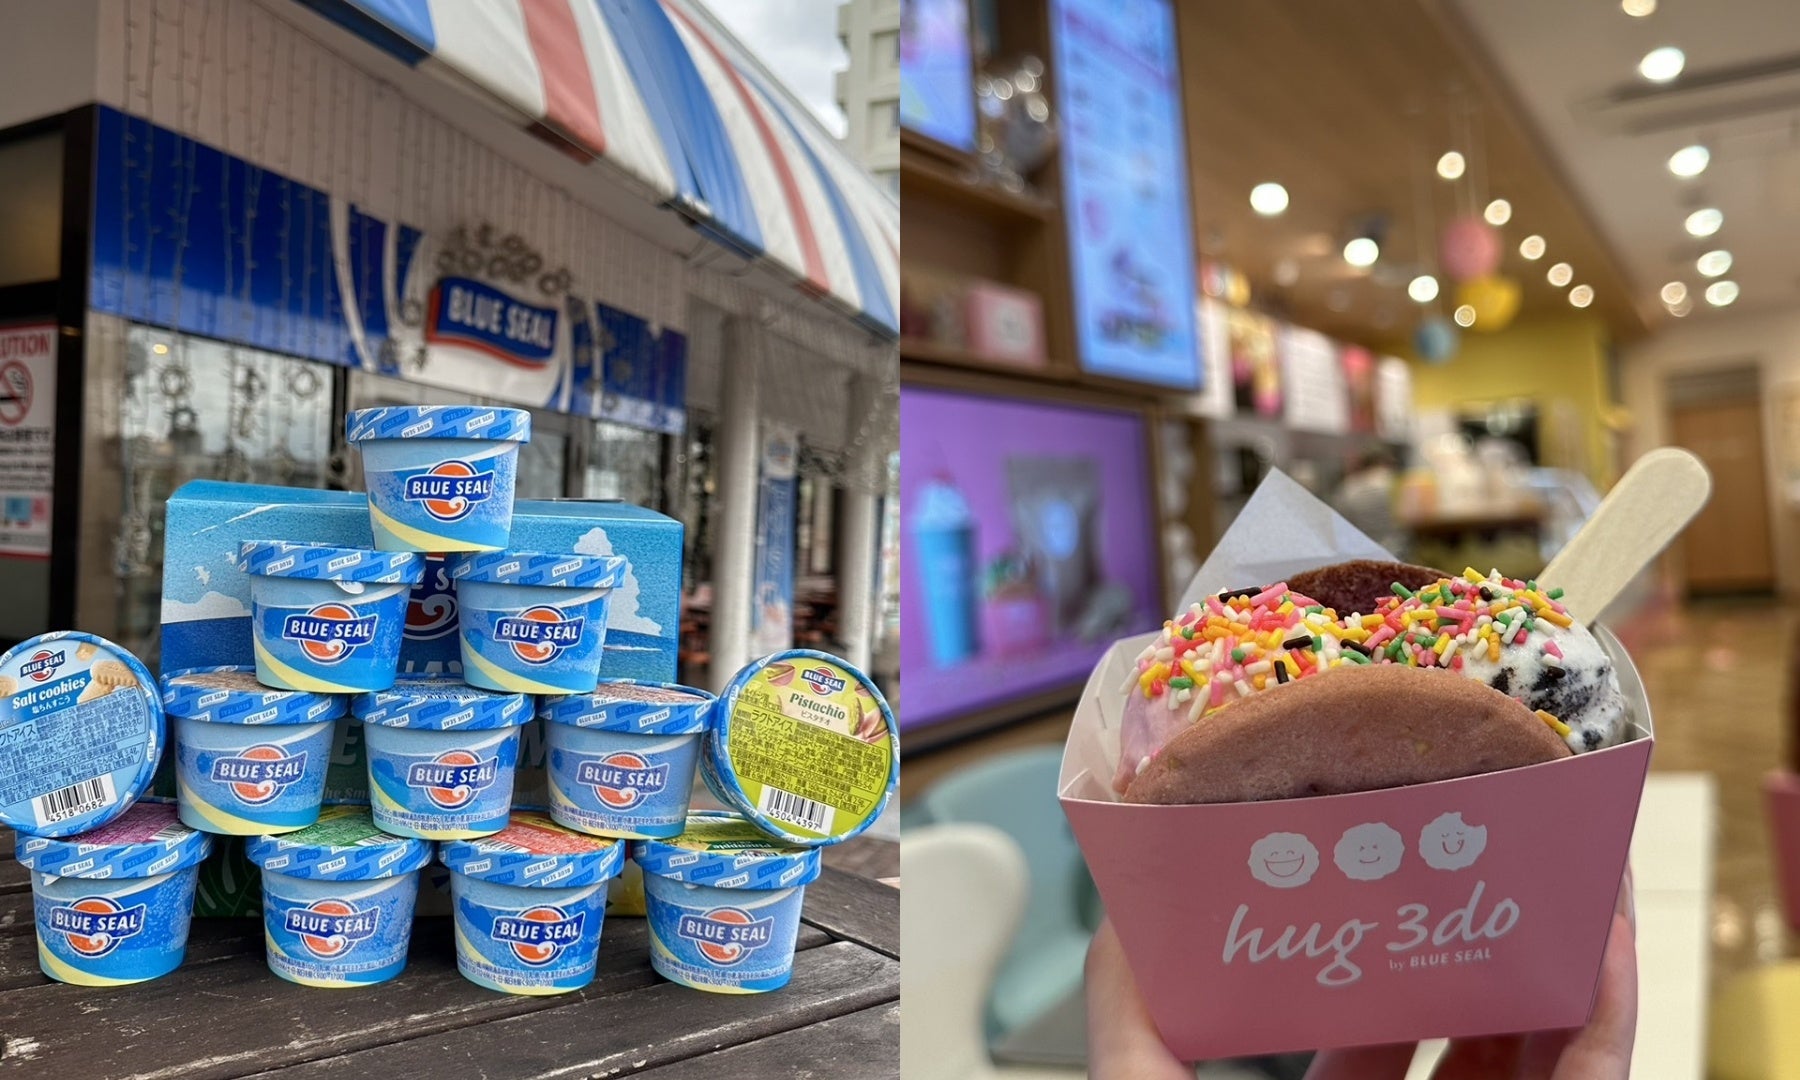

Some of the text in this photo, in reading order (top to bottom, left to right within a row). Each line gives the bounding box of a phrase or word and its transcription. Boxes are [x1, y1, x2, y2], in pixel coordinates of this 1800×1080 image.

[448, 285, 551, 350] BLUE SEAL
[0, 334, 49, 357] UTION
[412, 480, 489, 495] BLUE SEAL
[291, 620, 371, 638] BLUE SEAL
[501, 622, 578, 640] BLUE SEAL
[22, 654, 63, 674] BLUE SEAL
[803, 670, 843, 689] BLUE SEAL
[12, 677, 86, 710] Salt cookies
[789, 692, 846, 720] Pistachio
[751, 709, 793, 733] ラクトアイス
[220, 763, 300, 778] BLUE SEAL
[415, 767, 492, 784] BLUE SEAL
[584, 766, 662, 786] BLUE SEAL
[49, 798, 104, 822] 4518 0682
[769, 809, 819, 830] 4504 4397
[62, 861, 92, 874] BLUE SEAL
[150, 854, 177, 871] BLUE SEAL
[527, 859, 555, 874] BLUE SEAL
[56, 912, 138, 930] BLUE SEAL
[291, 914, 372, 933] BLUE SEAL
[500, 922, 579, 939] BLUE SEAL
[686, 920, 767, 941] BLUE SEAL
[1222, 880, 1520, 986] hug 3do
[1389, 948, 1492, 971] by BLUE SEAL
